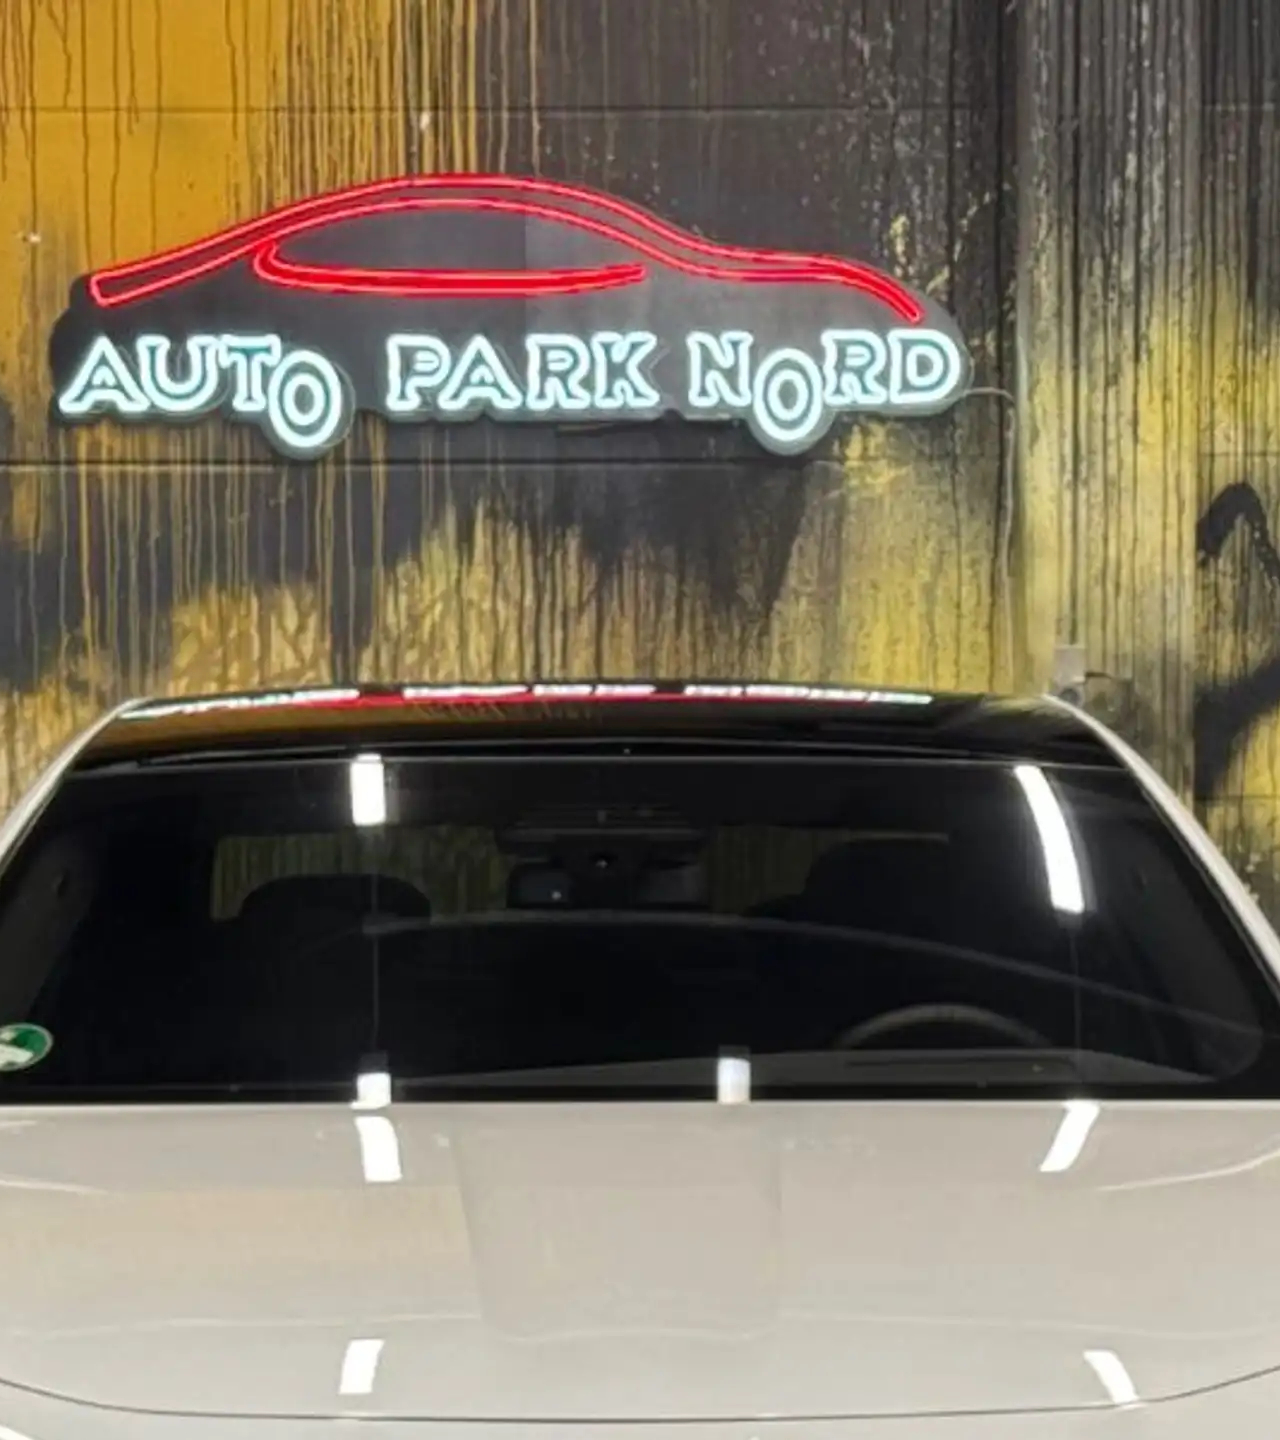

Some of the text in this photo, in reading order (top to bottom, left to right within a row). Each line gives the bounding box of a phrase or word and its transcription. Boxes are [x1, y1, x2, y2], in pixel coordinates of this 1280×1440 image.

[58, 328, 963, 449] AUTO PARK NORD
